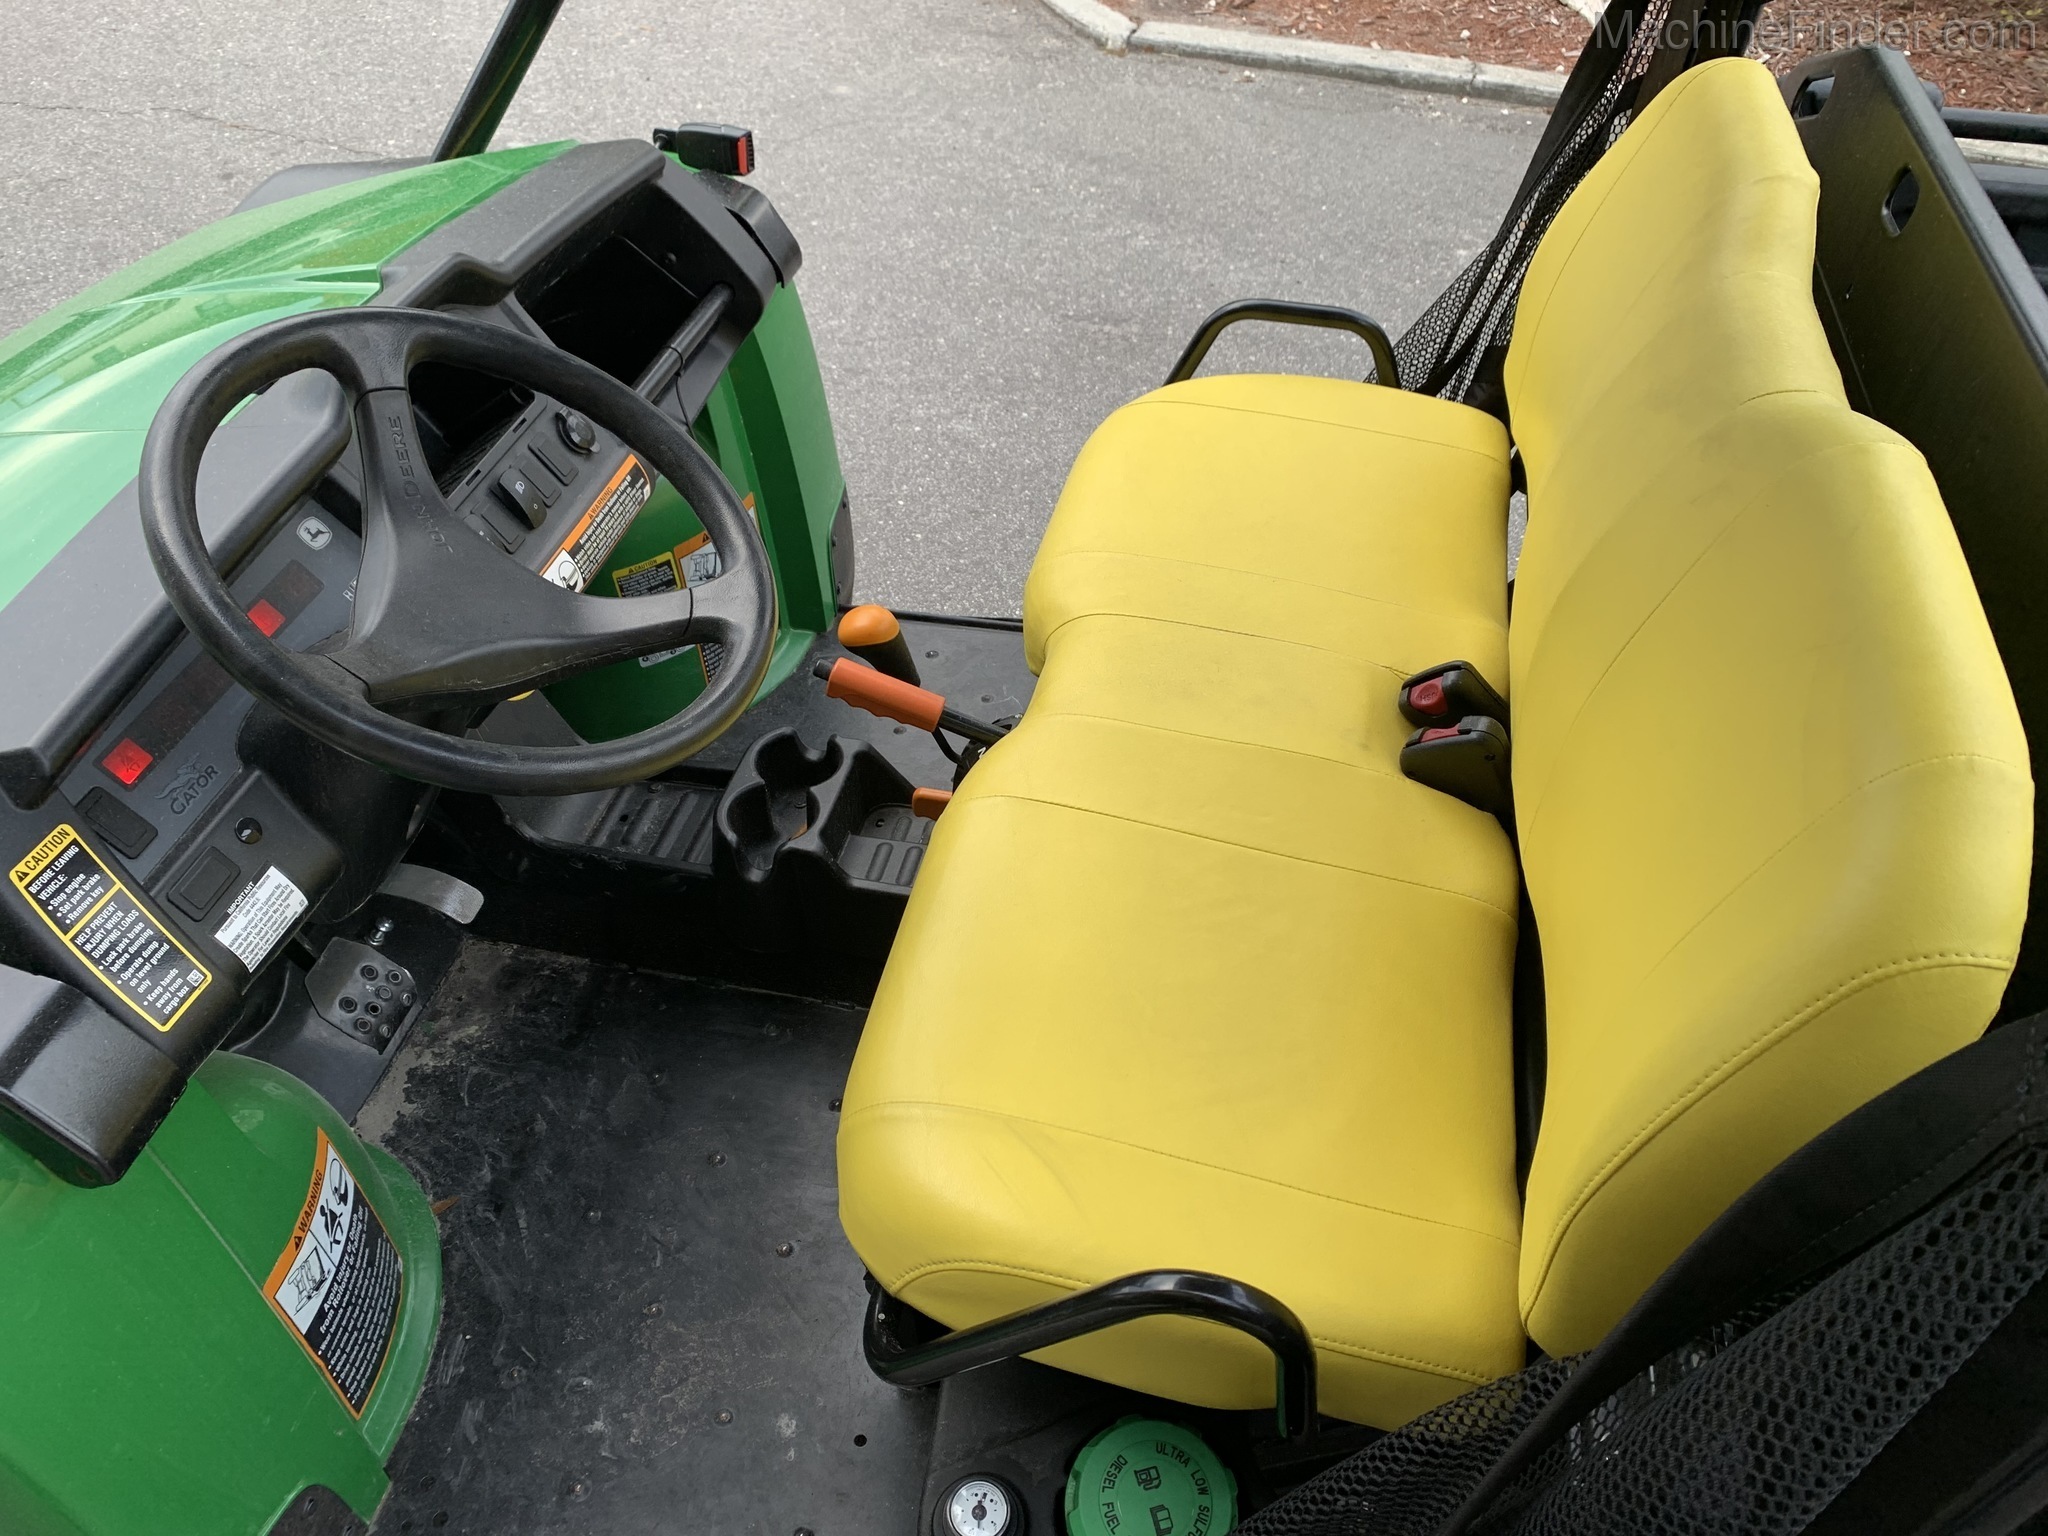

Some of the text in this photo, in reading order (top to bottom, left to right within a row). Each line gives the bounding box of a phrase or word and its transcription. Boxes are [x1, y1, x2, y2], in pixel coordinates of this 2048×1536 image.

[388, 416, 420, 498] DEERE
[590, 486, 613, 515] WARNING
[634, 559, 658, 571] CAUTION
[170, 765, 219, 814] GATOR
[24, 828, 70, 871] CAUTION
[29, 845, 79, 893] BEFORE LEAVING
[38, 873, 68, 900] VEHICLE:
[50, 873, 86, 906] Stop engine
[59, 873, 101, 914] Set park brake
[68, 886, 104, 920] Remove key
[227, 881, 255, 914] IMPORTANT
[75, 901, 118, 945] HELP PREVENT
[83, 910, 124, 952] INJURY WHEN
[91, 909, 139, 959] DUMPING LOADS
[101, 921, 144, 966] Lock park brake
[110, 928, 153, 973] before dumping
[120, 940, 160, 981] Operate dump
[129, 943, 169, 987] on level ground
[137, 979, 151, 994] only
[146, 967, 178, 1002] Keep hands
[155, 977, 183, 1008] away from
[162, 985, 189, 1015] cargo box
[298, 1169, 322, 1233] WARNING
[320, 1310, 334, 1333] from
[334, 1267, 350, 1308] Rollover
[349, 1254, 354, 1265] or
[353, 1222, 361, 1253] Falling
[325, 1282, 338, 1312] Avoid
[337, 1254, 348, 1282] Injury
[347, 1241, 351, 1252] or
[1101, 1454, 1128, 1493] DIESEL
[1156, 1442, 1190, 1468] ULTRA
[1190, 1469, 1210, 1496] LOW
[1102, 1502, 1120, 1535] FUEL
